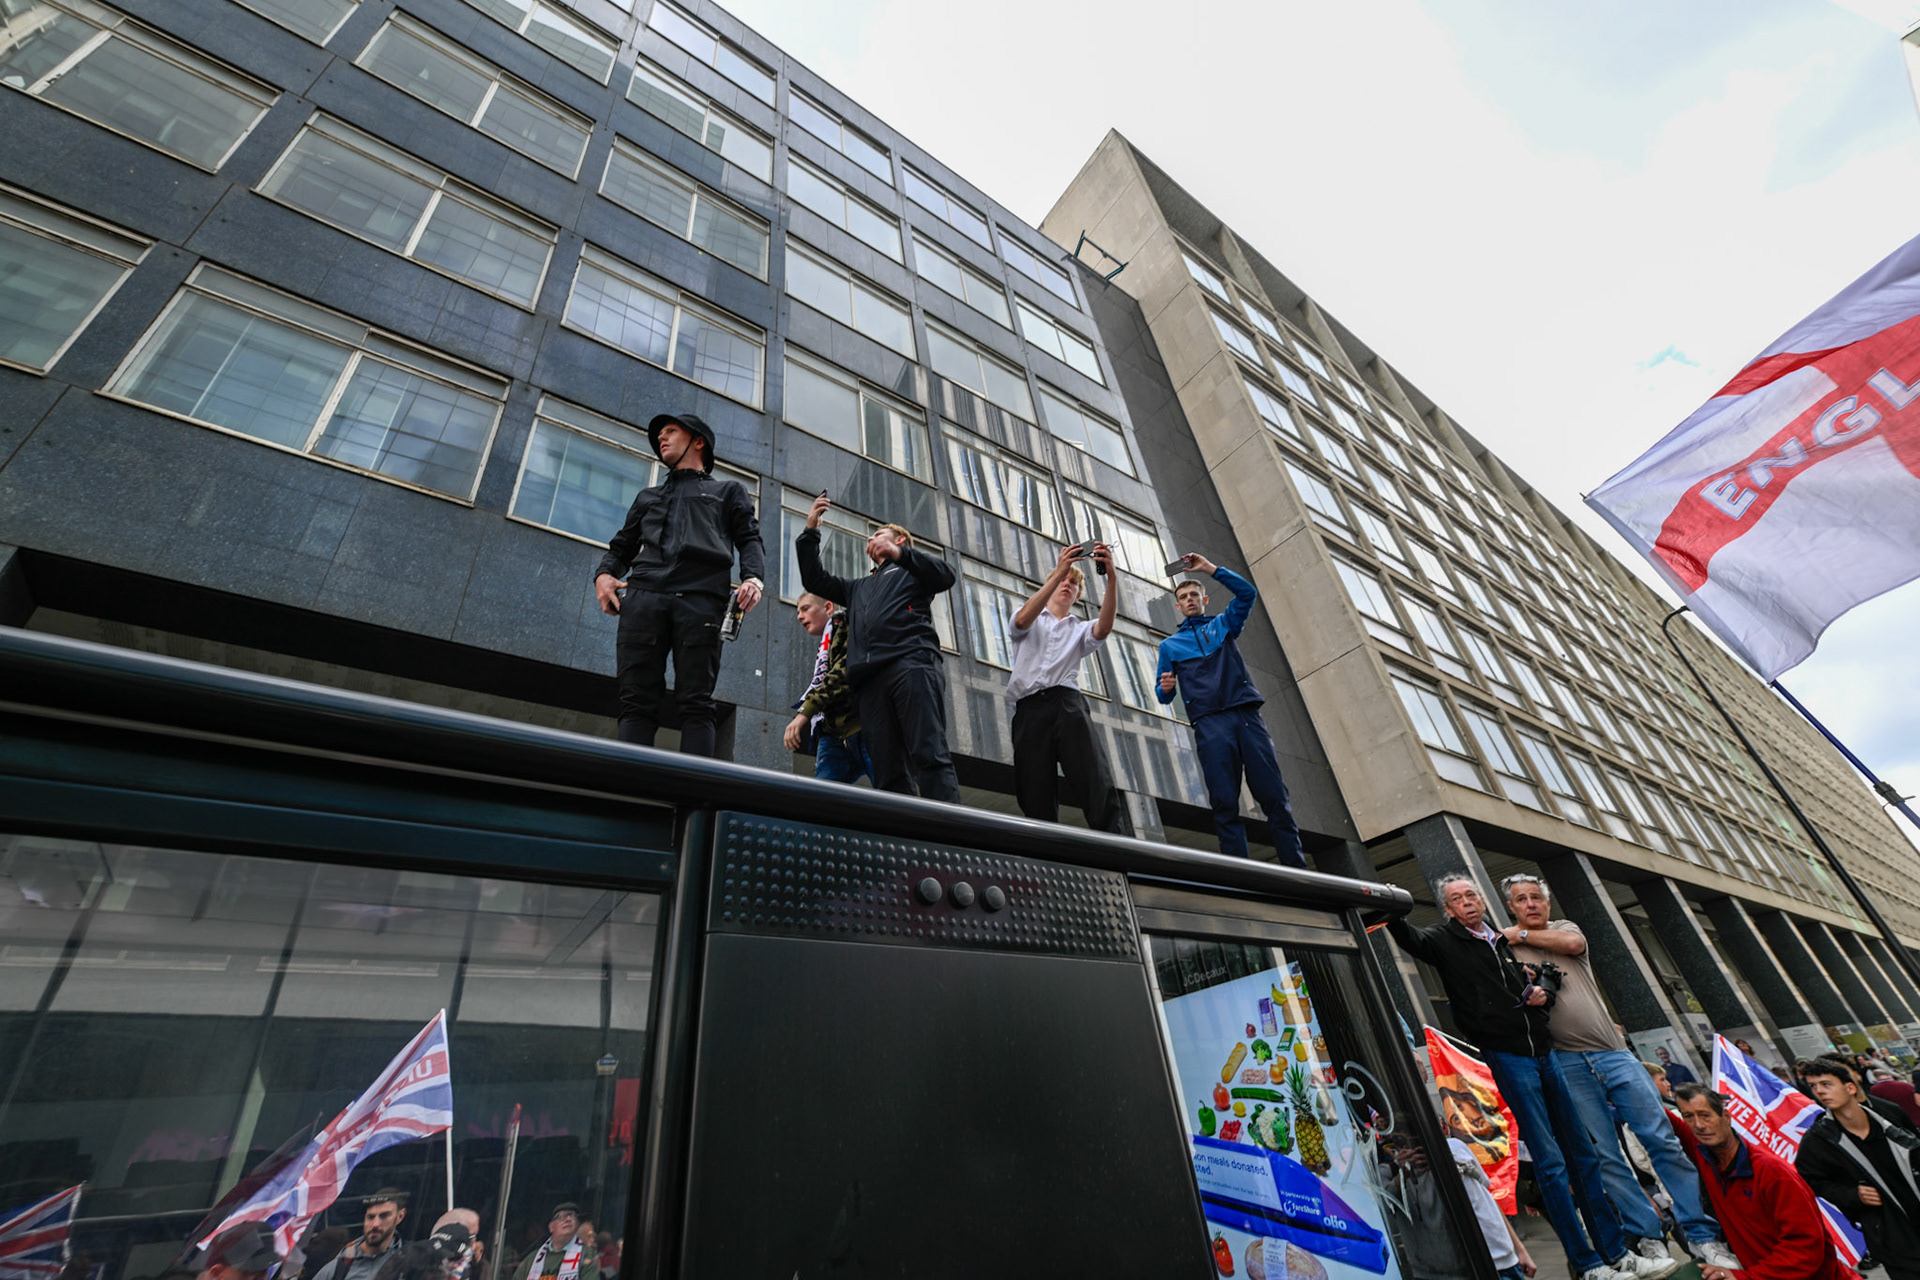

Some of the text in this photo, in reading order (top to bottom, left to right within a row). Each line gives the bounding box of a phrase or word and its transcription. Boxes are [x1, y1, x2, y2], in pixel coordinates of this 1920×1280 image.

[1183, 965, 1228, 987] JCDecaux
[1749, 1115, 1770, 1144] THE
[1207, 1156, 1230, 1167] meals
[1231, 1159, 1269, 1176] donated.
[1323, 1215, 1347, 1231] olio
